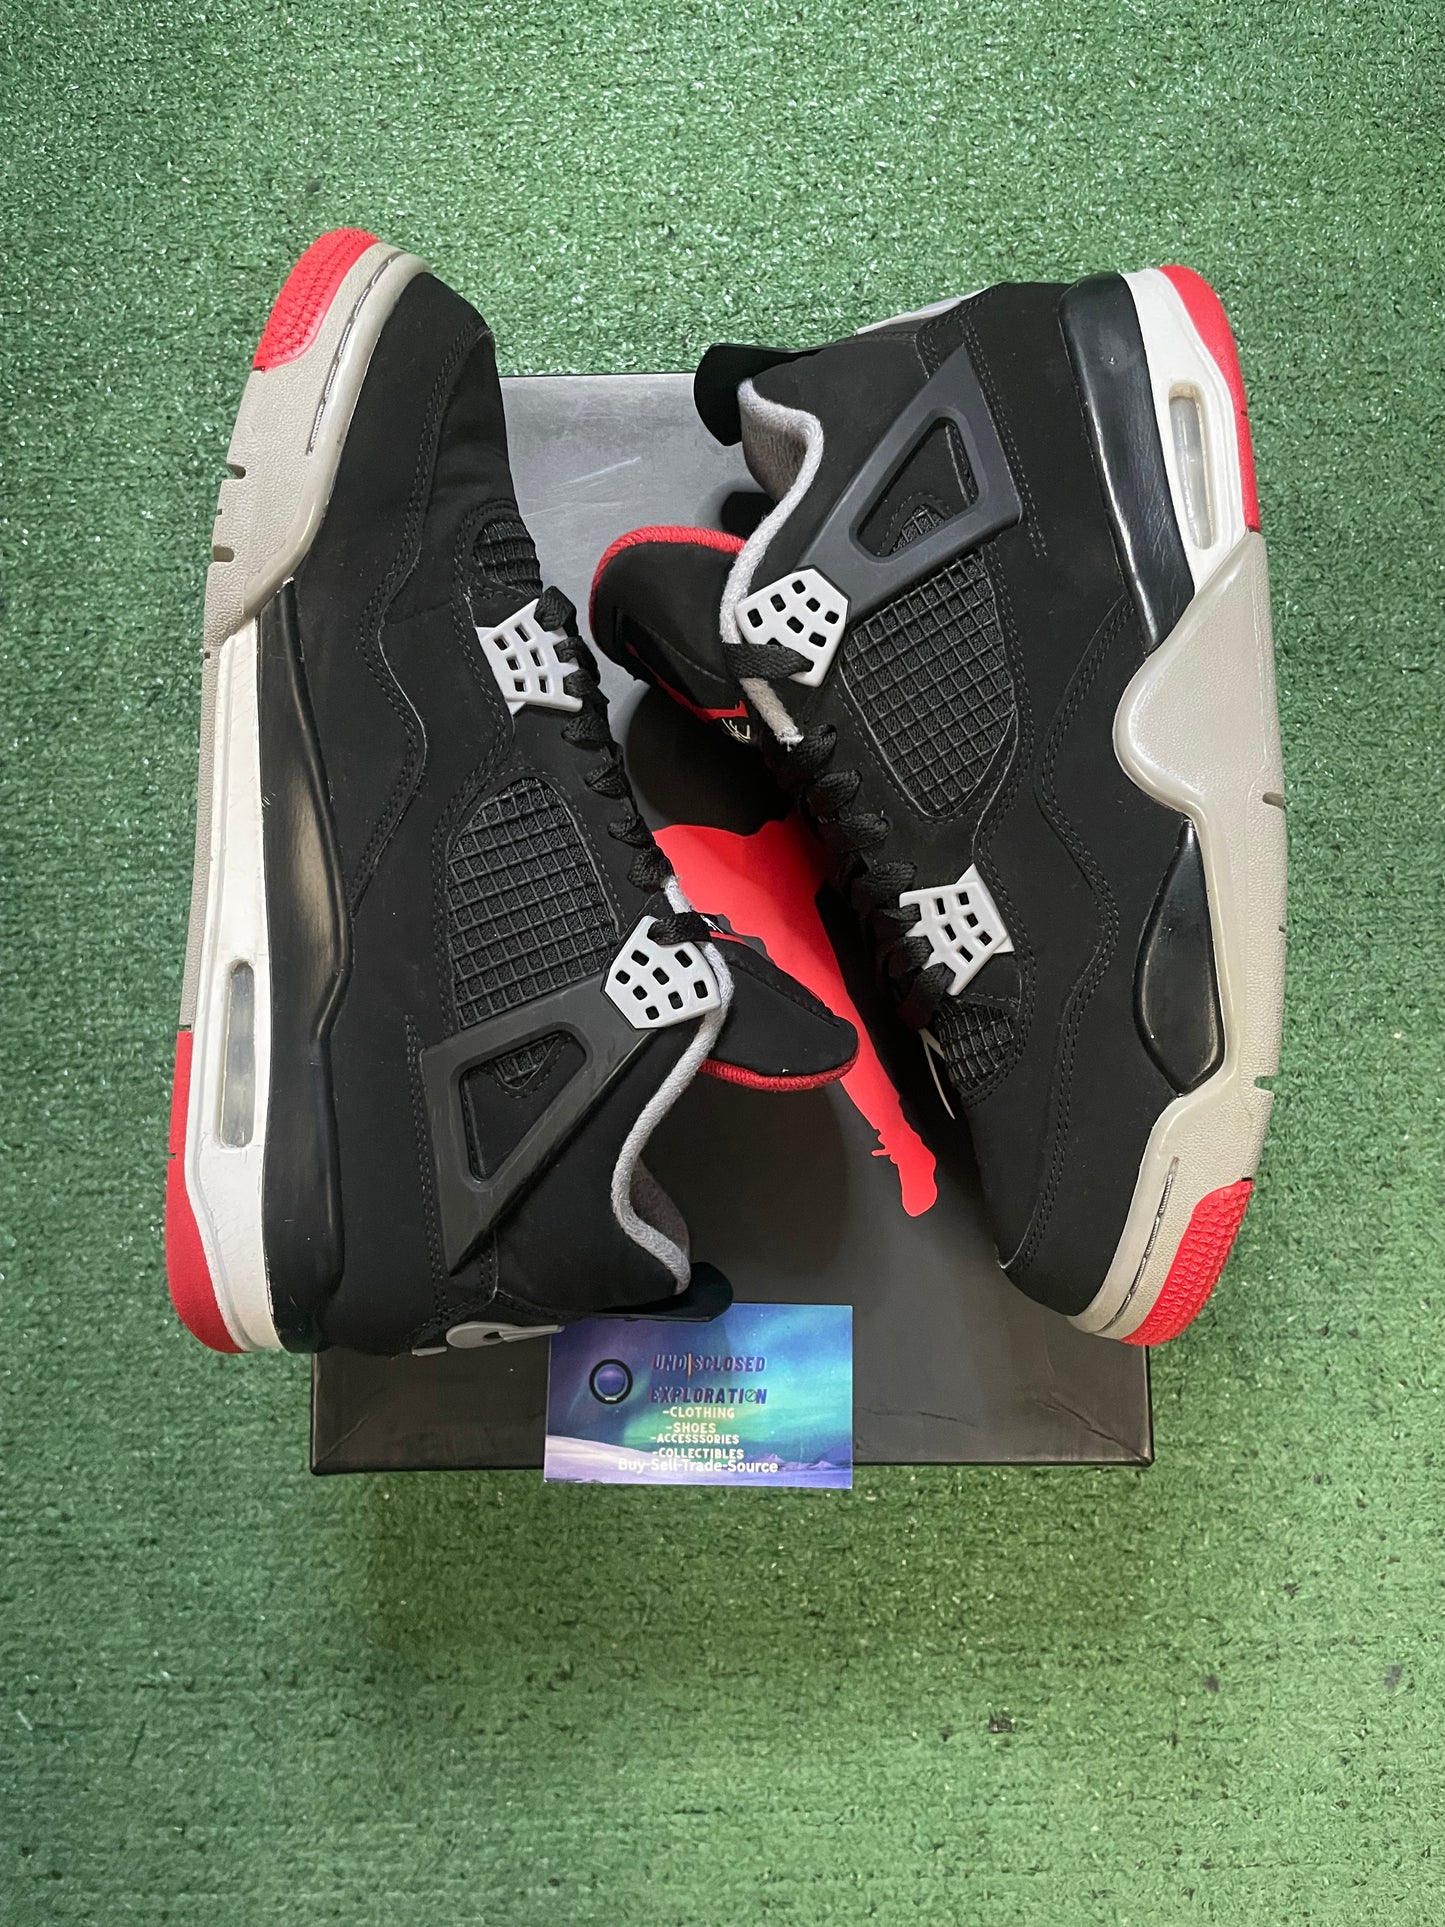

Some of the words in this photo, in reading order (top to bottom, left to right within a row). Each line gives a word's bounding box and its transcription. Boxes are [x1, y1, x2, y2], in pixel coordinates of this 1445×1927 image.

[652, 1353, 767, 1377] UNDISCLOSED
[650, 1386, 768, 1404] EXPLORATION
[662, 1406, 735, 1419] -CLOTHING
[665, 1422, 717, 1434] -SHOES
[652, 1447, 744, 1459] -COLLECTIBLES
[618, 1458, 779, 1474] Buy-Sell-Trade-Source
